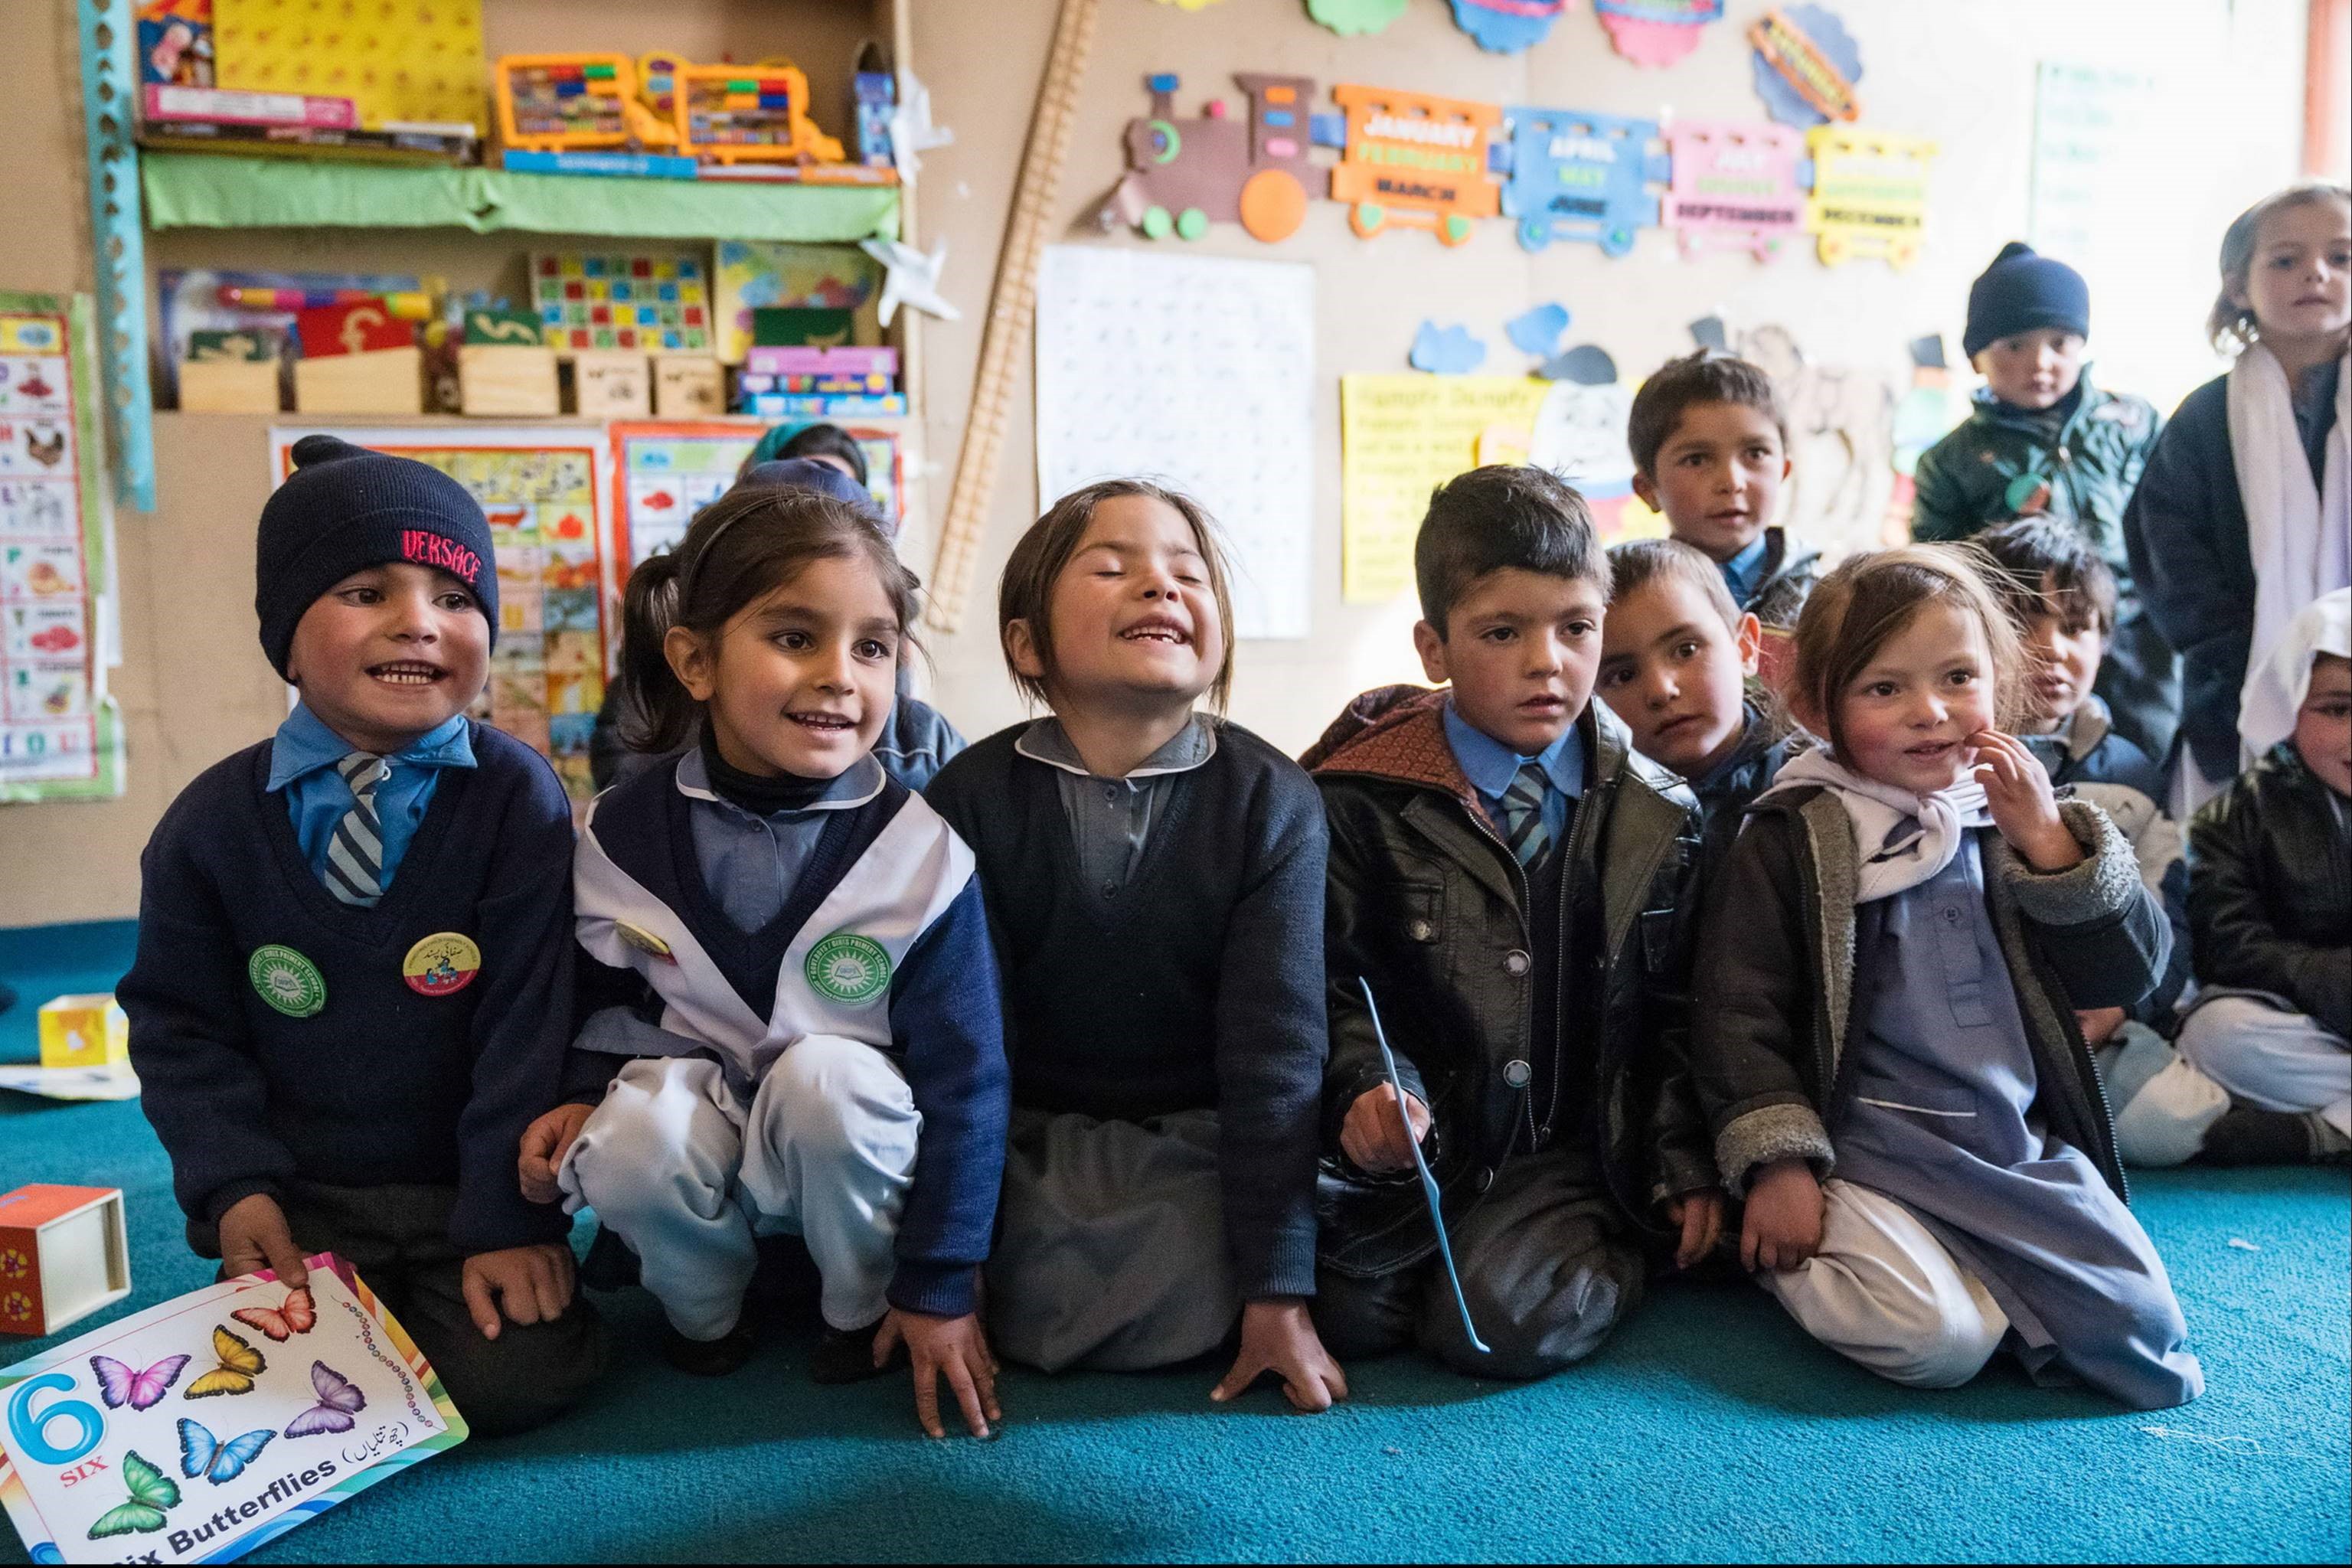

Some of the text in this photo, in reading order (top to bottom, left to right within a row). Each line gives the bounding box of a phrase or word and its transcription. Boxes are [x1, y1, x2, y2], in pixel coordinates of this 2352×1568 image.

[1364, 115, 1476, 148] JANUARY
[1549, 136, 1616, 163] APRIL
[1377, 178, 1456, 202] MARCH
[1677, 203, 1794, 226] SEPTEMBER
[402, 529, 482, 583] VERSACE
[8, 1373, 105, 1465] 6
[60, 1455, 109, 1488] SIX
[167, 1460, 337, 1556] Butterflies
